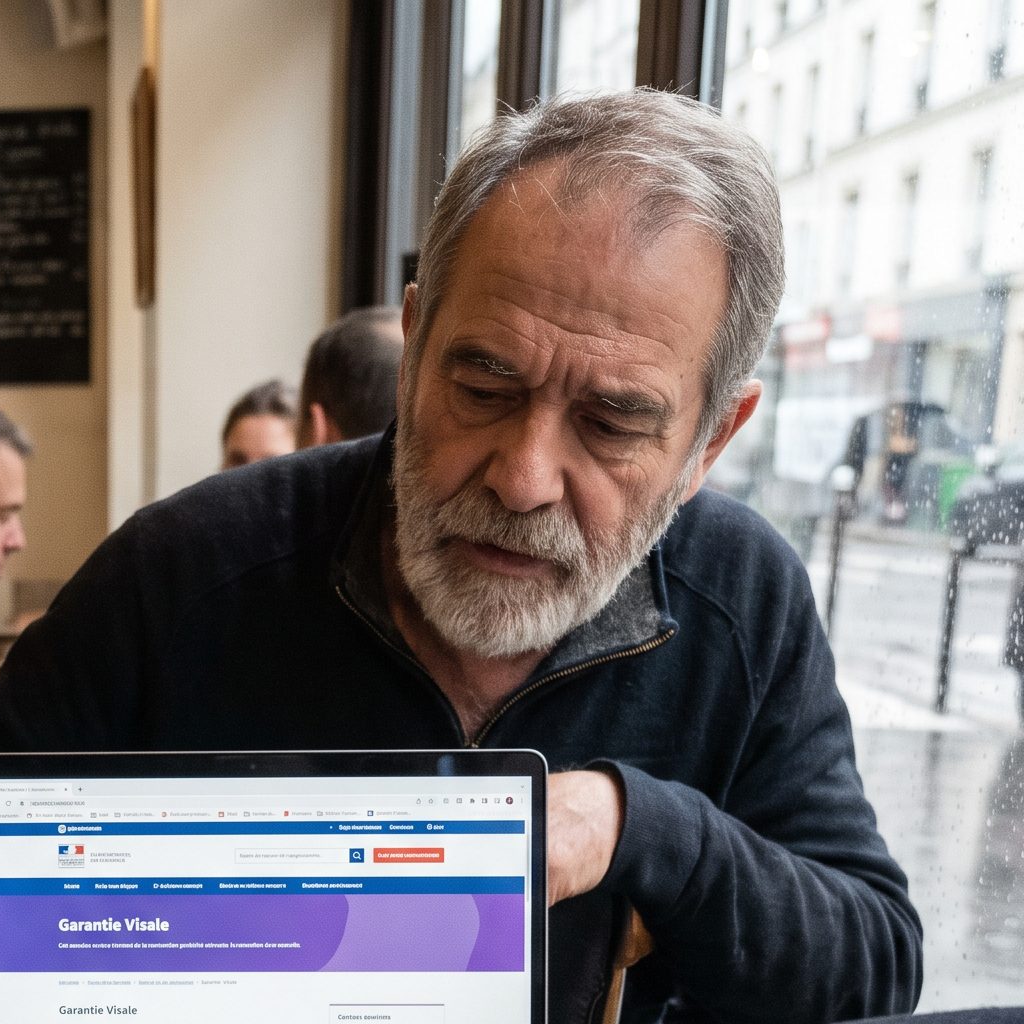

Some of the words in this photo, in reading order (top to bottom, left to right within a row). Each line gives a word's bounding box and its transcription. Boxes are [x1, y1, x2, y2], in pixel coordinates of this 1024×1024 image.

[58, 917, 122, 932] Garantie
[124, 917, 170, 932] Visale
[58, 1005, 104, 1016] Garantie
[106, 1005, 138, 1016] Visale
